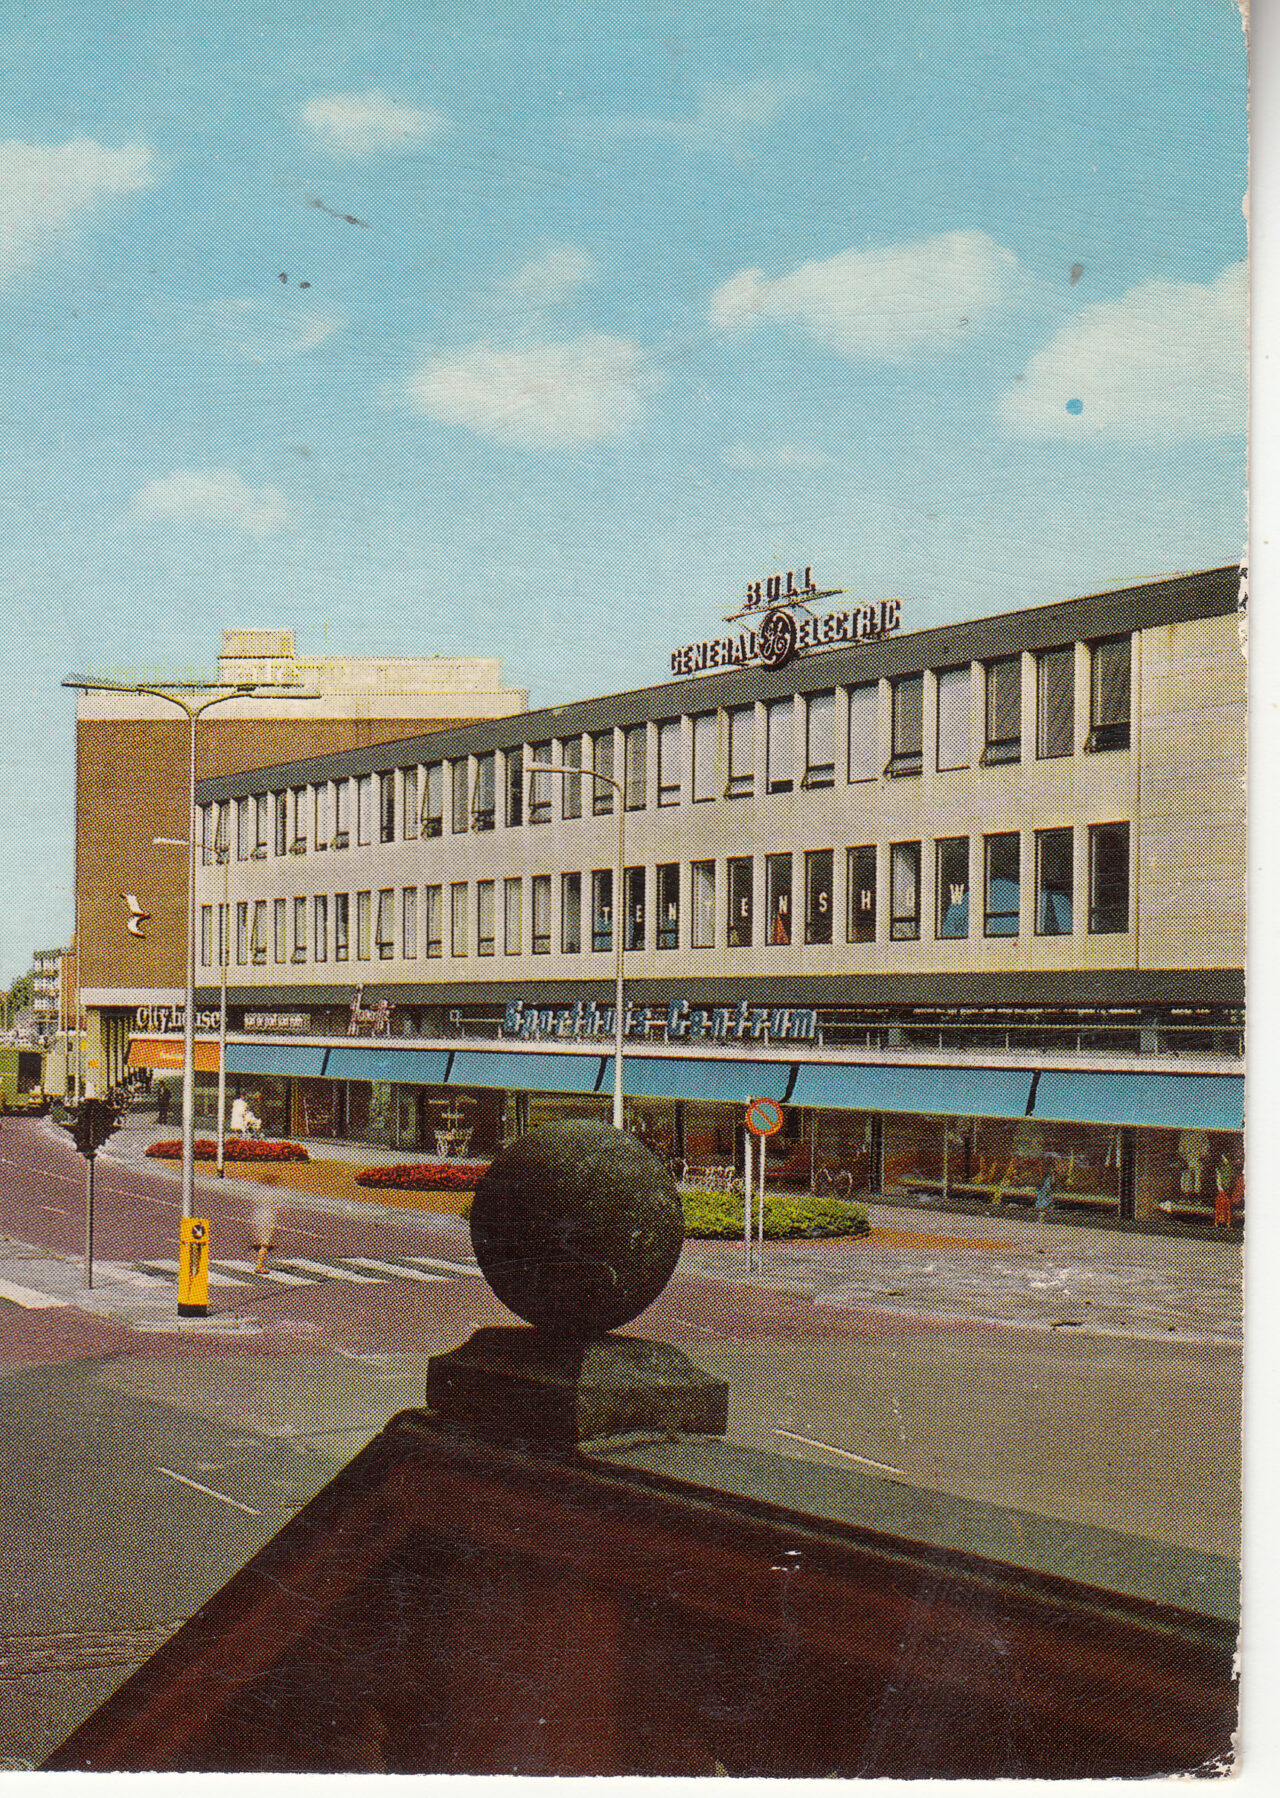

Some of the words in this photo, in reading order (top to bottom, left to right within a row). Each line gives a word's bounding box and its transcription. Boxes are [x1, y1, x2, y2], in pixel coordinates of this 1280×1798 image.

[744, 566, 817, 608] BULL
[670, 630, 760, 676] GENERAL
[795, 598, 901, 650] ELECTRIC
[666, 999, 818, 1039] Centrum
